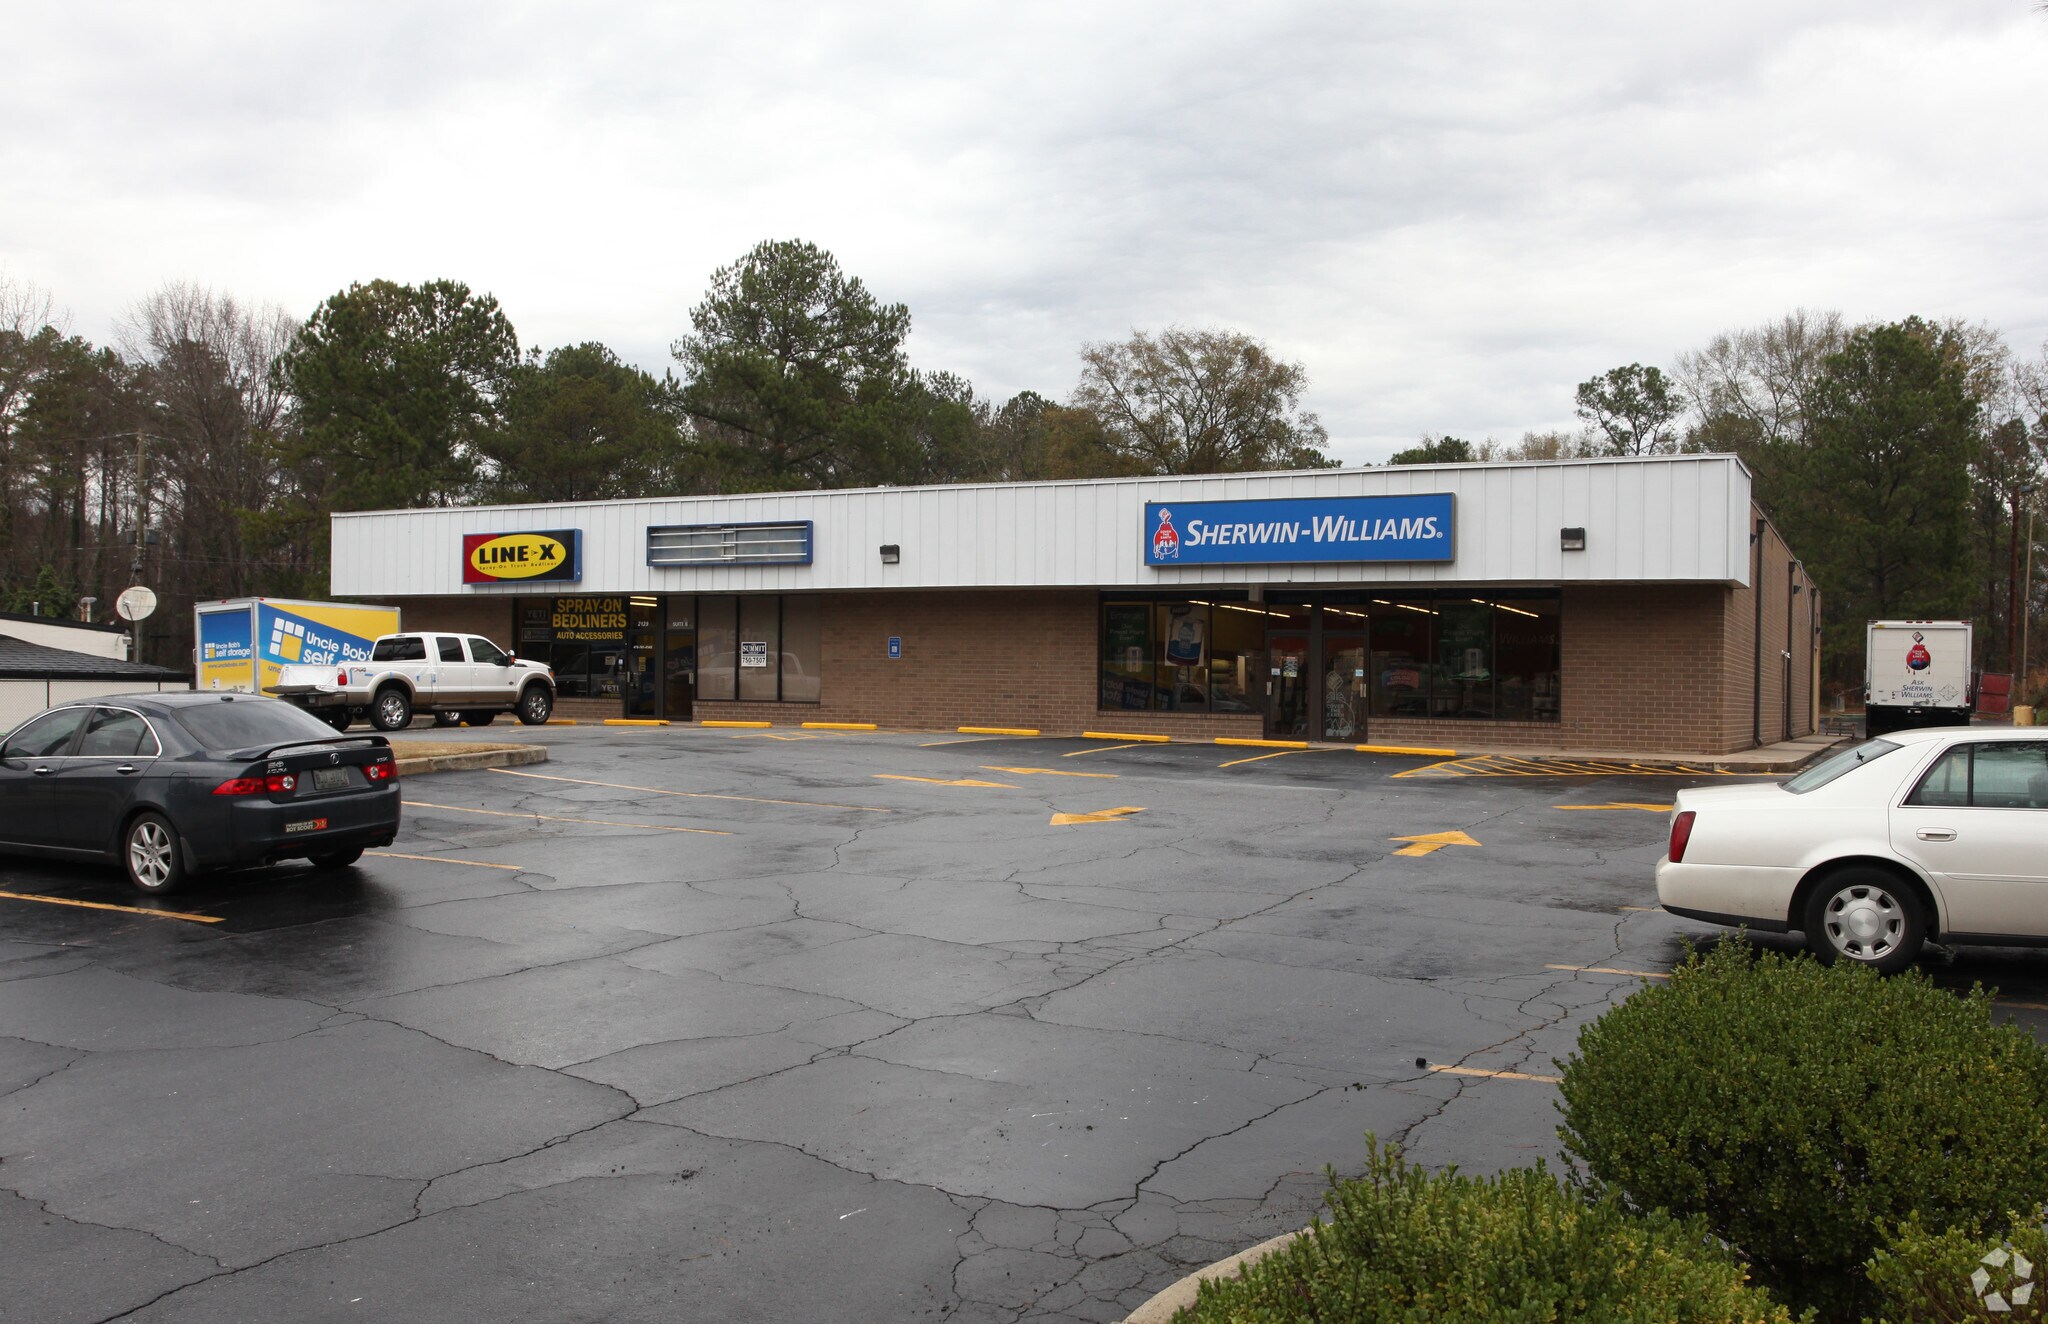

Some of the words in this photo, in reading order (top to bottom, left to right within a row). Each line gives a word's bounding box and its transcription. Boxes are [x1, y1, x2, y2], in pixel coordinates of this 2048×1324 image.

[557, 599, 622, 613] SPRAY-ON
[552, 613, 627, 628] BEDLINERS
[556, 631, 575, 640] AUTO
[575, 631, 624, 640] ACCESSORIES
[228, 641, 241, 649] Bob's
[306, 631, 340, 652] Uncle
[215, 648, 227, 657] self
[227, 648, 251, 657] storage
[742, 644, 766, 653] SUMMIT
[742, 656, 766, 664] 750-7507
[601, 684, 619, 692] YETI
[1901, 691, 1933, 699] WILLIAMS
